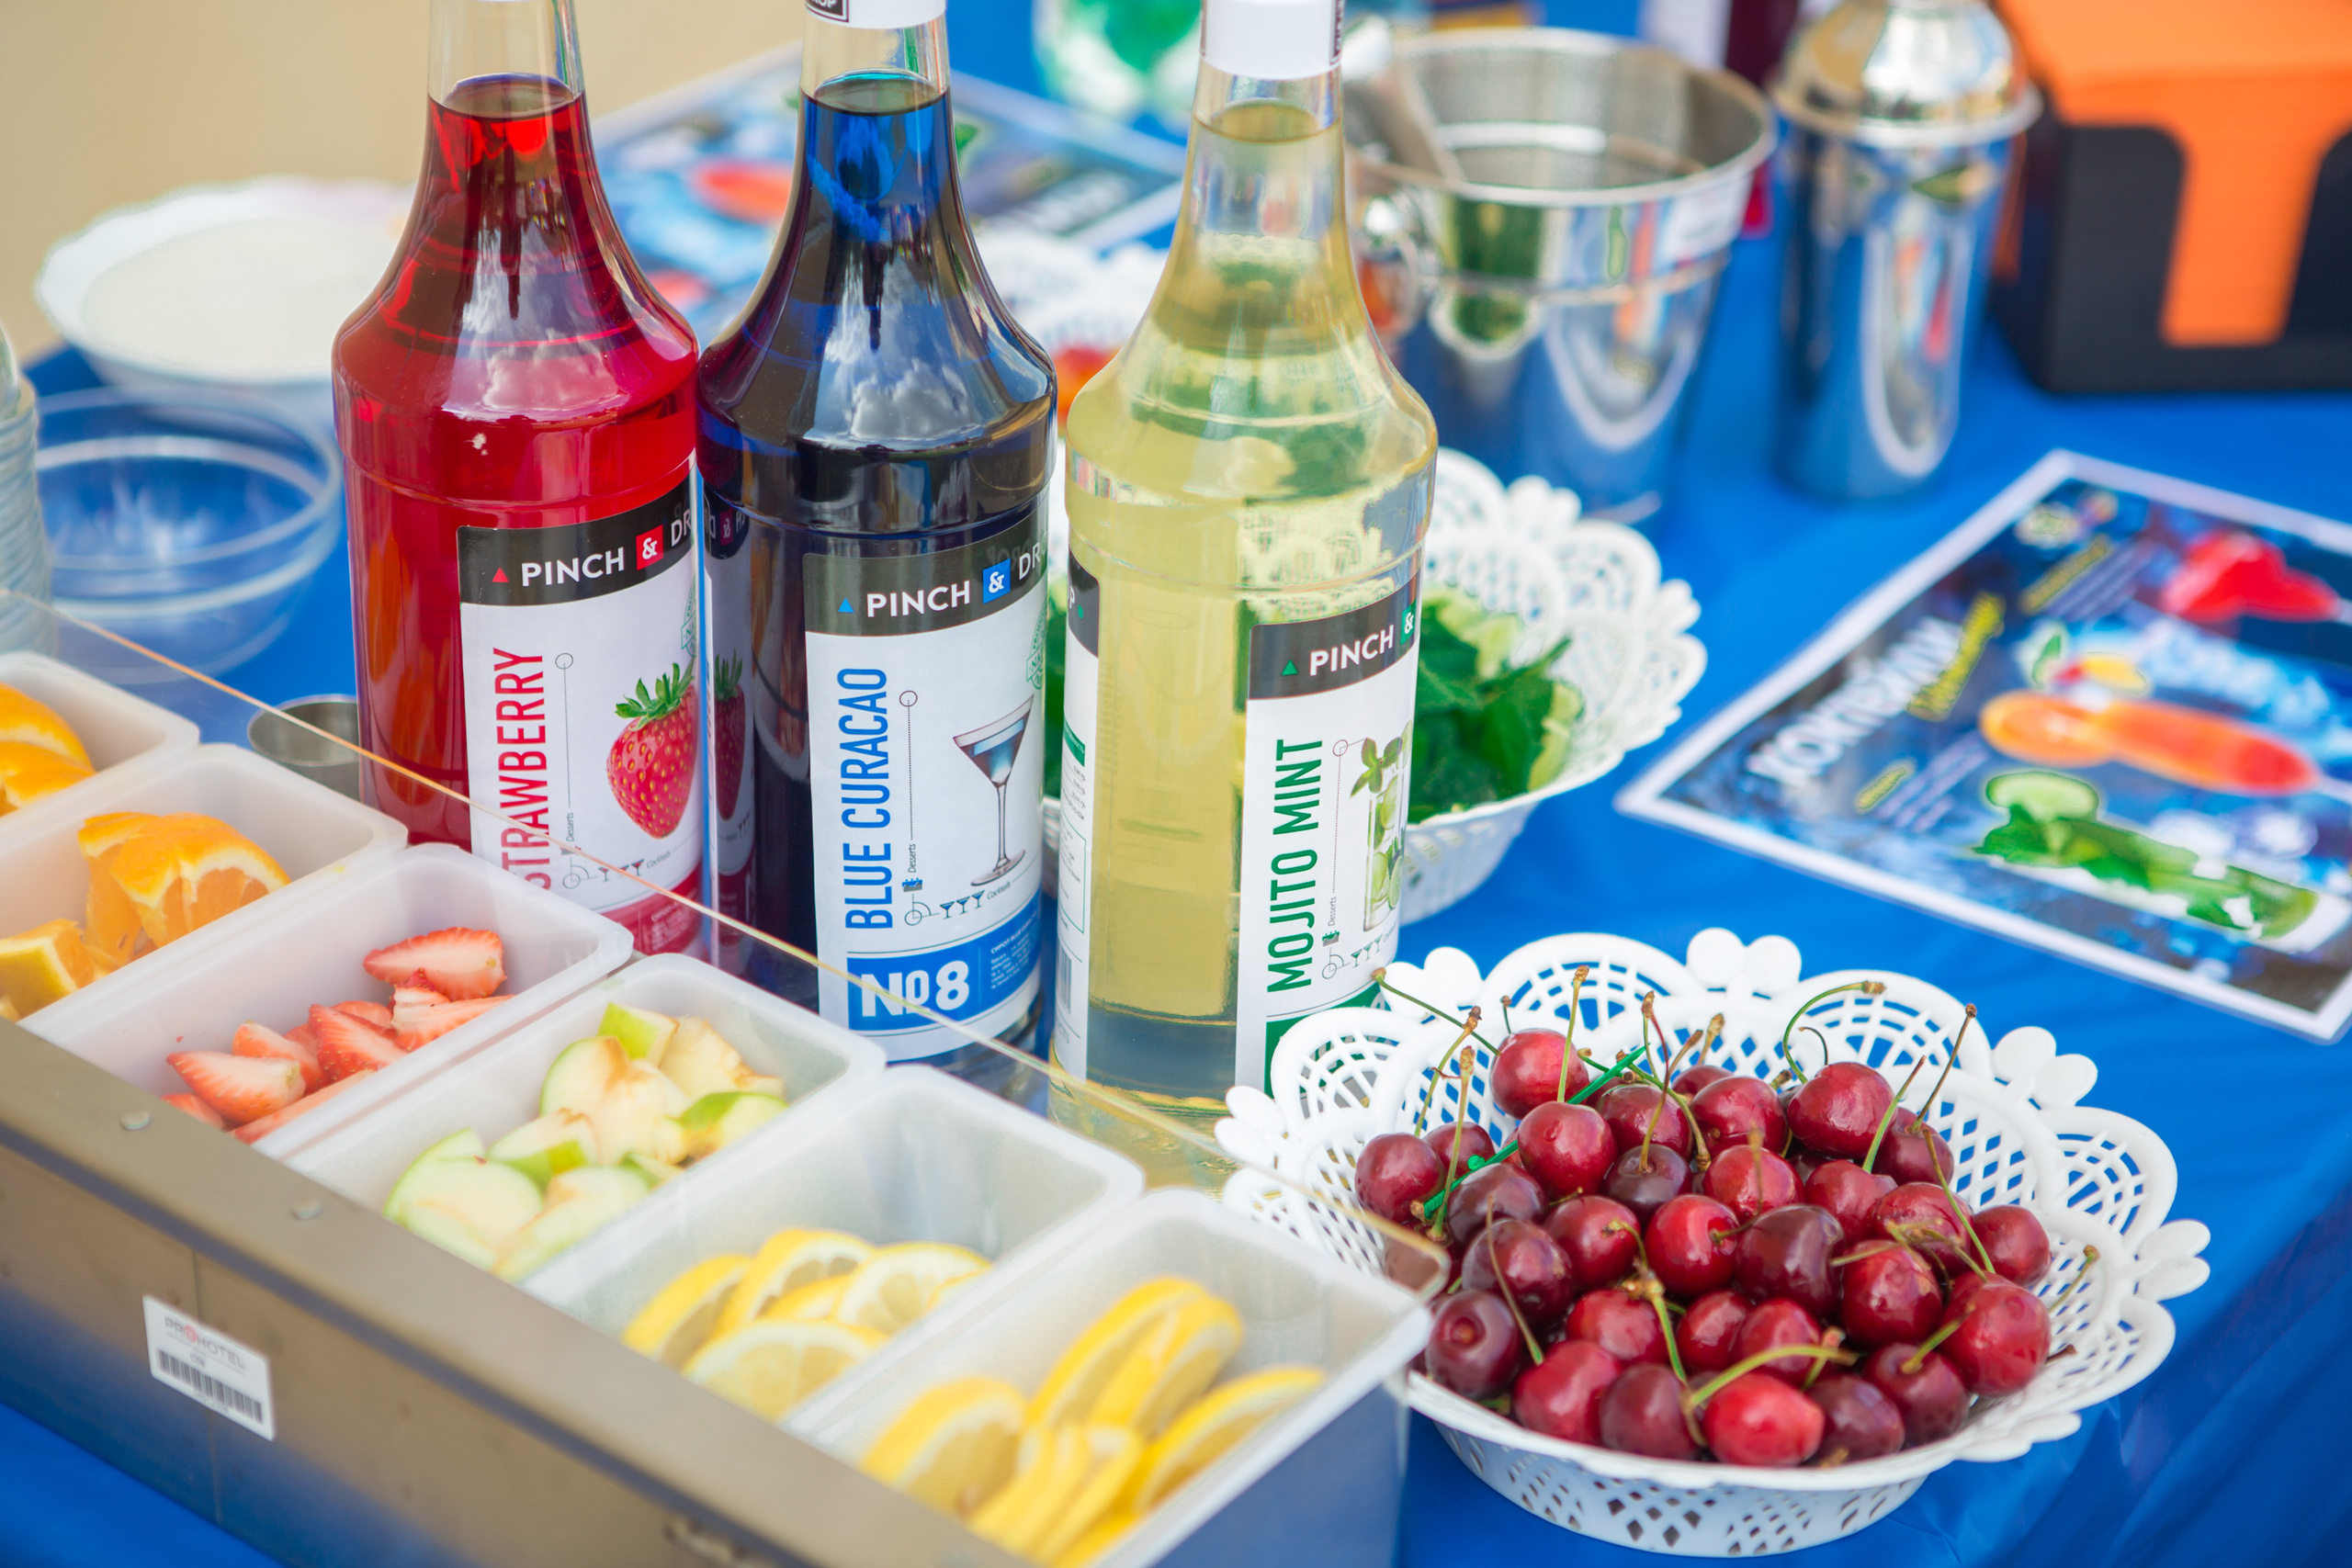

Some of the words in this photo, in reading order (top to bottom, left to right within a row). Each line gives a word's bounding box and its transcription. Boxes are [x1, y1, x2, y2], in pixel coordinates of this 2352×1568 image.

[521, 547, 625, 587] PINCH
[641, 537, 658, 559] &
[866, 580, 970, 617] PINCH
[988, 570, 1005, 593] &
[1309, 624, 1395, 677] PINCH
[1404, 611, 1415, 635] &
[837, 669, 891, 829] CURACAO
[1272, 739, 1323, 836] MINT
[566, 812, 574, 841] Desserts
[842, 842, 893, 929] BLUE
[908, 843, 917, 873] Desserts
[1266, 849, 1319, 993] MOJITO
[1328, 897, 1337, 927] Desserts
